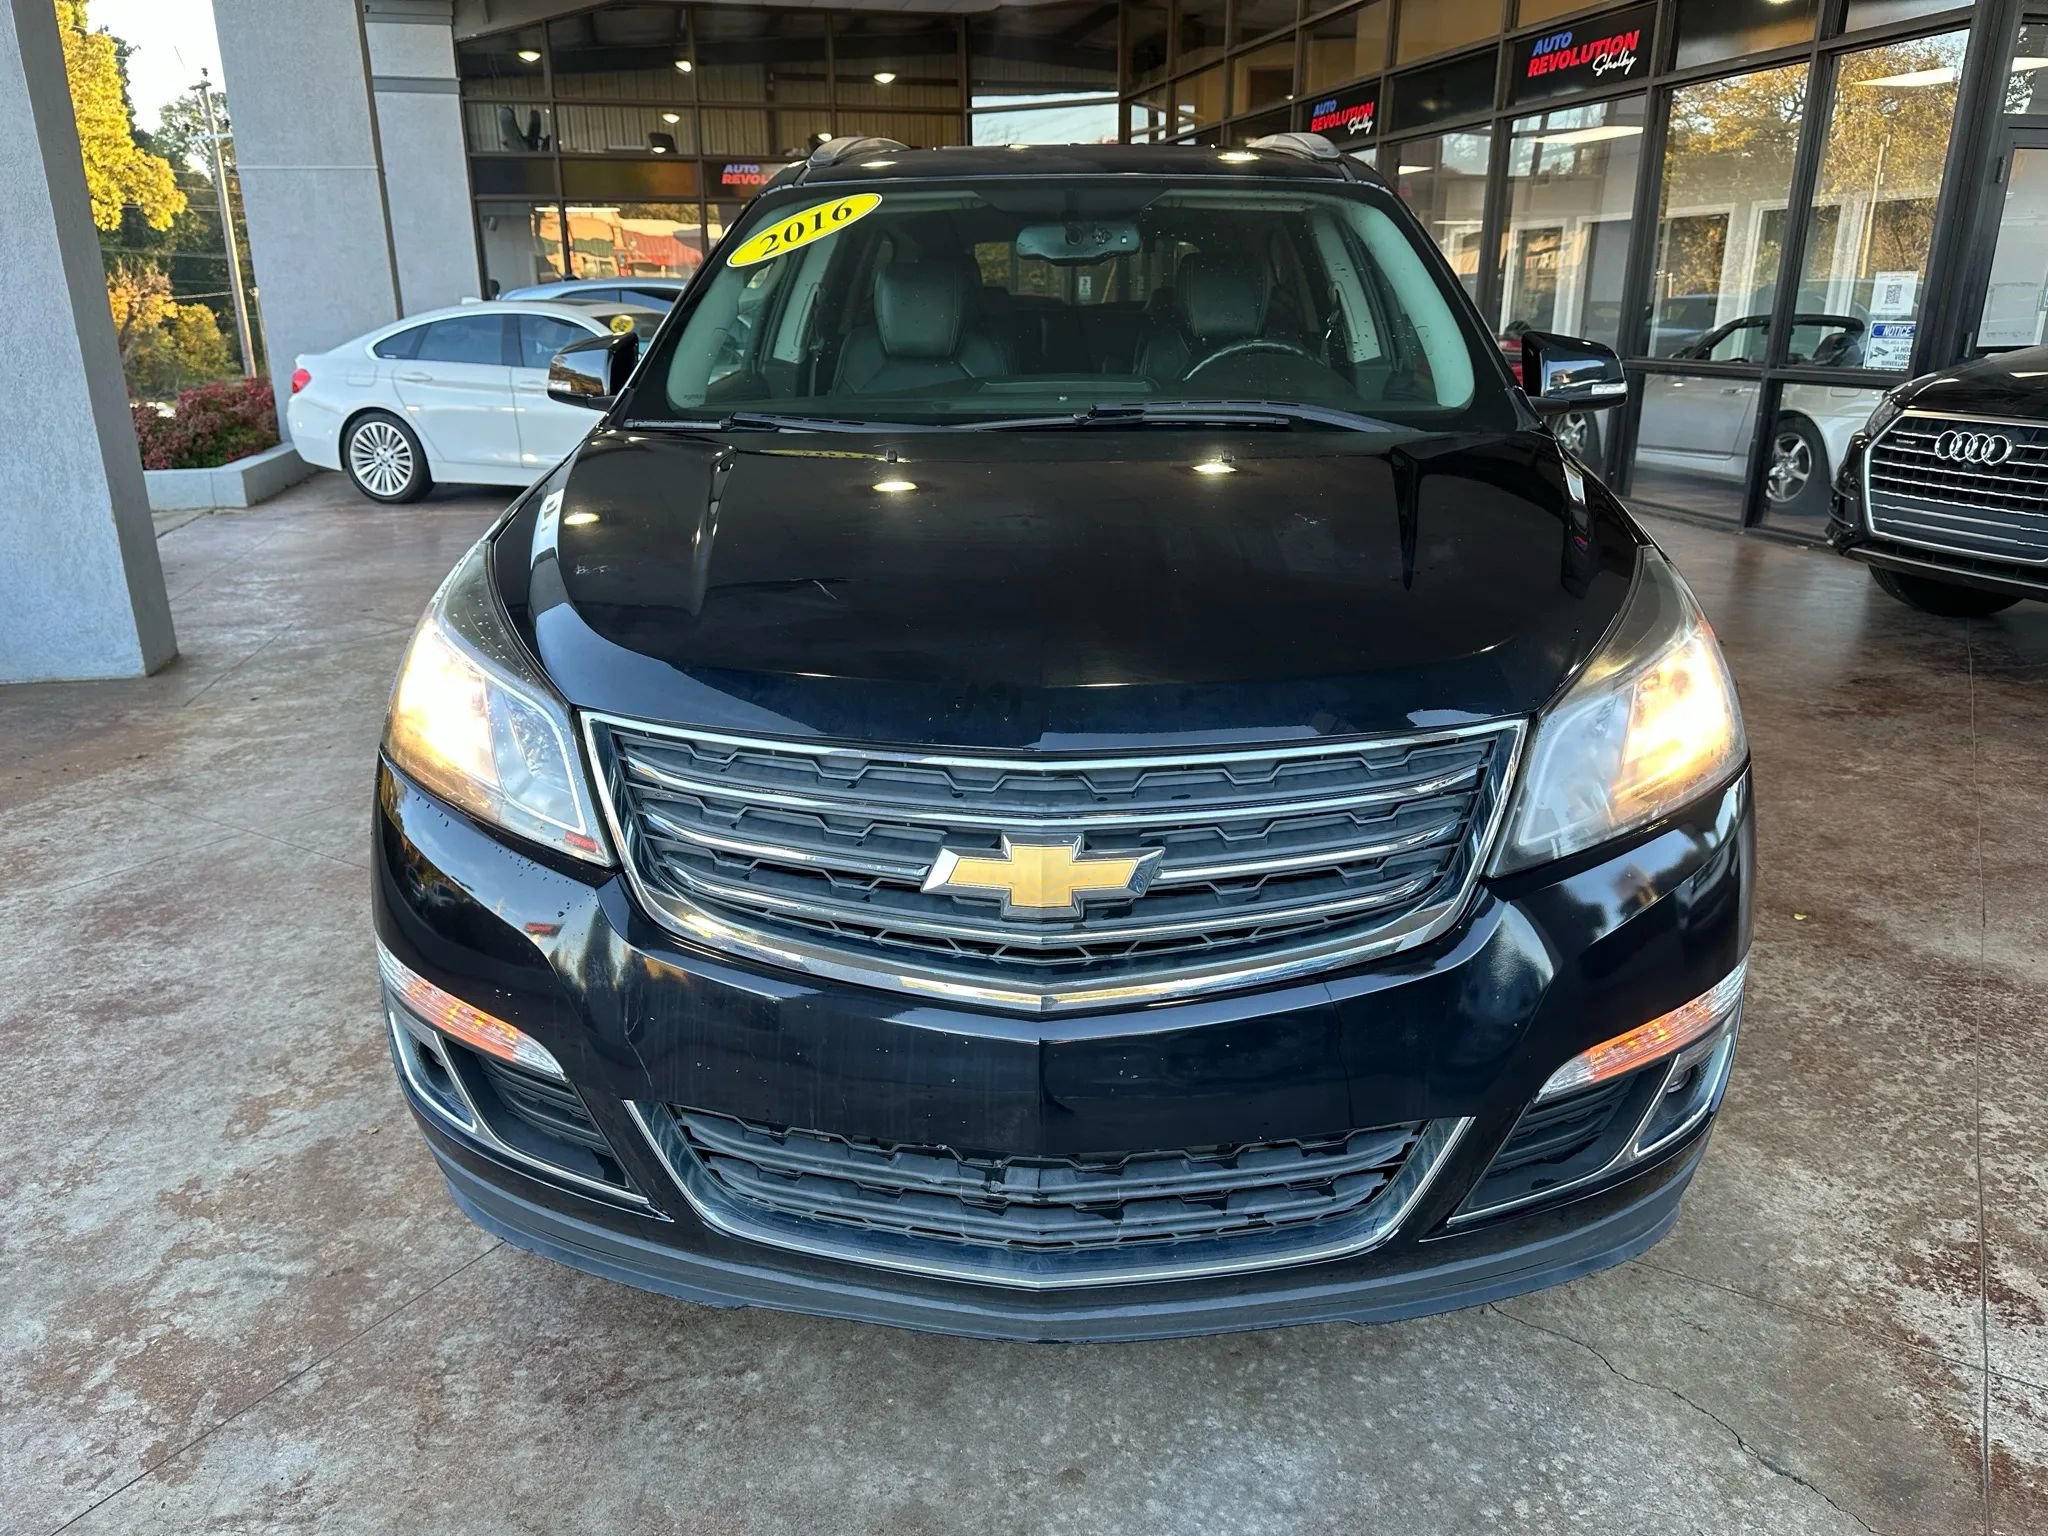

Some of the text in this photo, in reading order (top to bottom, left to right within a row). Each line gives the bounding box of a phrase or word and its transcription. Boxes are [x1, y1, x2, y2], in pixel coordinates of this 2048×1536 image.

[1527, 30, 1640, 77] REVOLUTION
[1532, 31, 1573, 56] AUTO
[1592, 47, 1637, 76] Shelby
[1311, 101, 1374, 132] REVOLUTION
[1313, 99, 1337, 117] AUTO
[723, 164, 759, 173] AUTO
[758, 200, 853, 256] 2016
[1882, 326, 1912, 337] NOTICE
